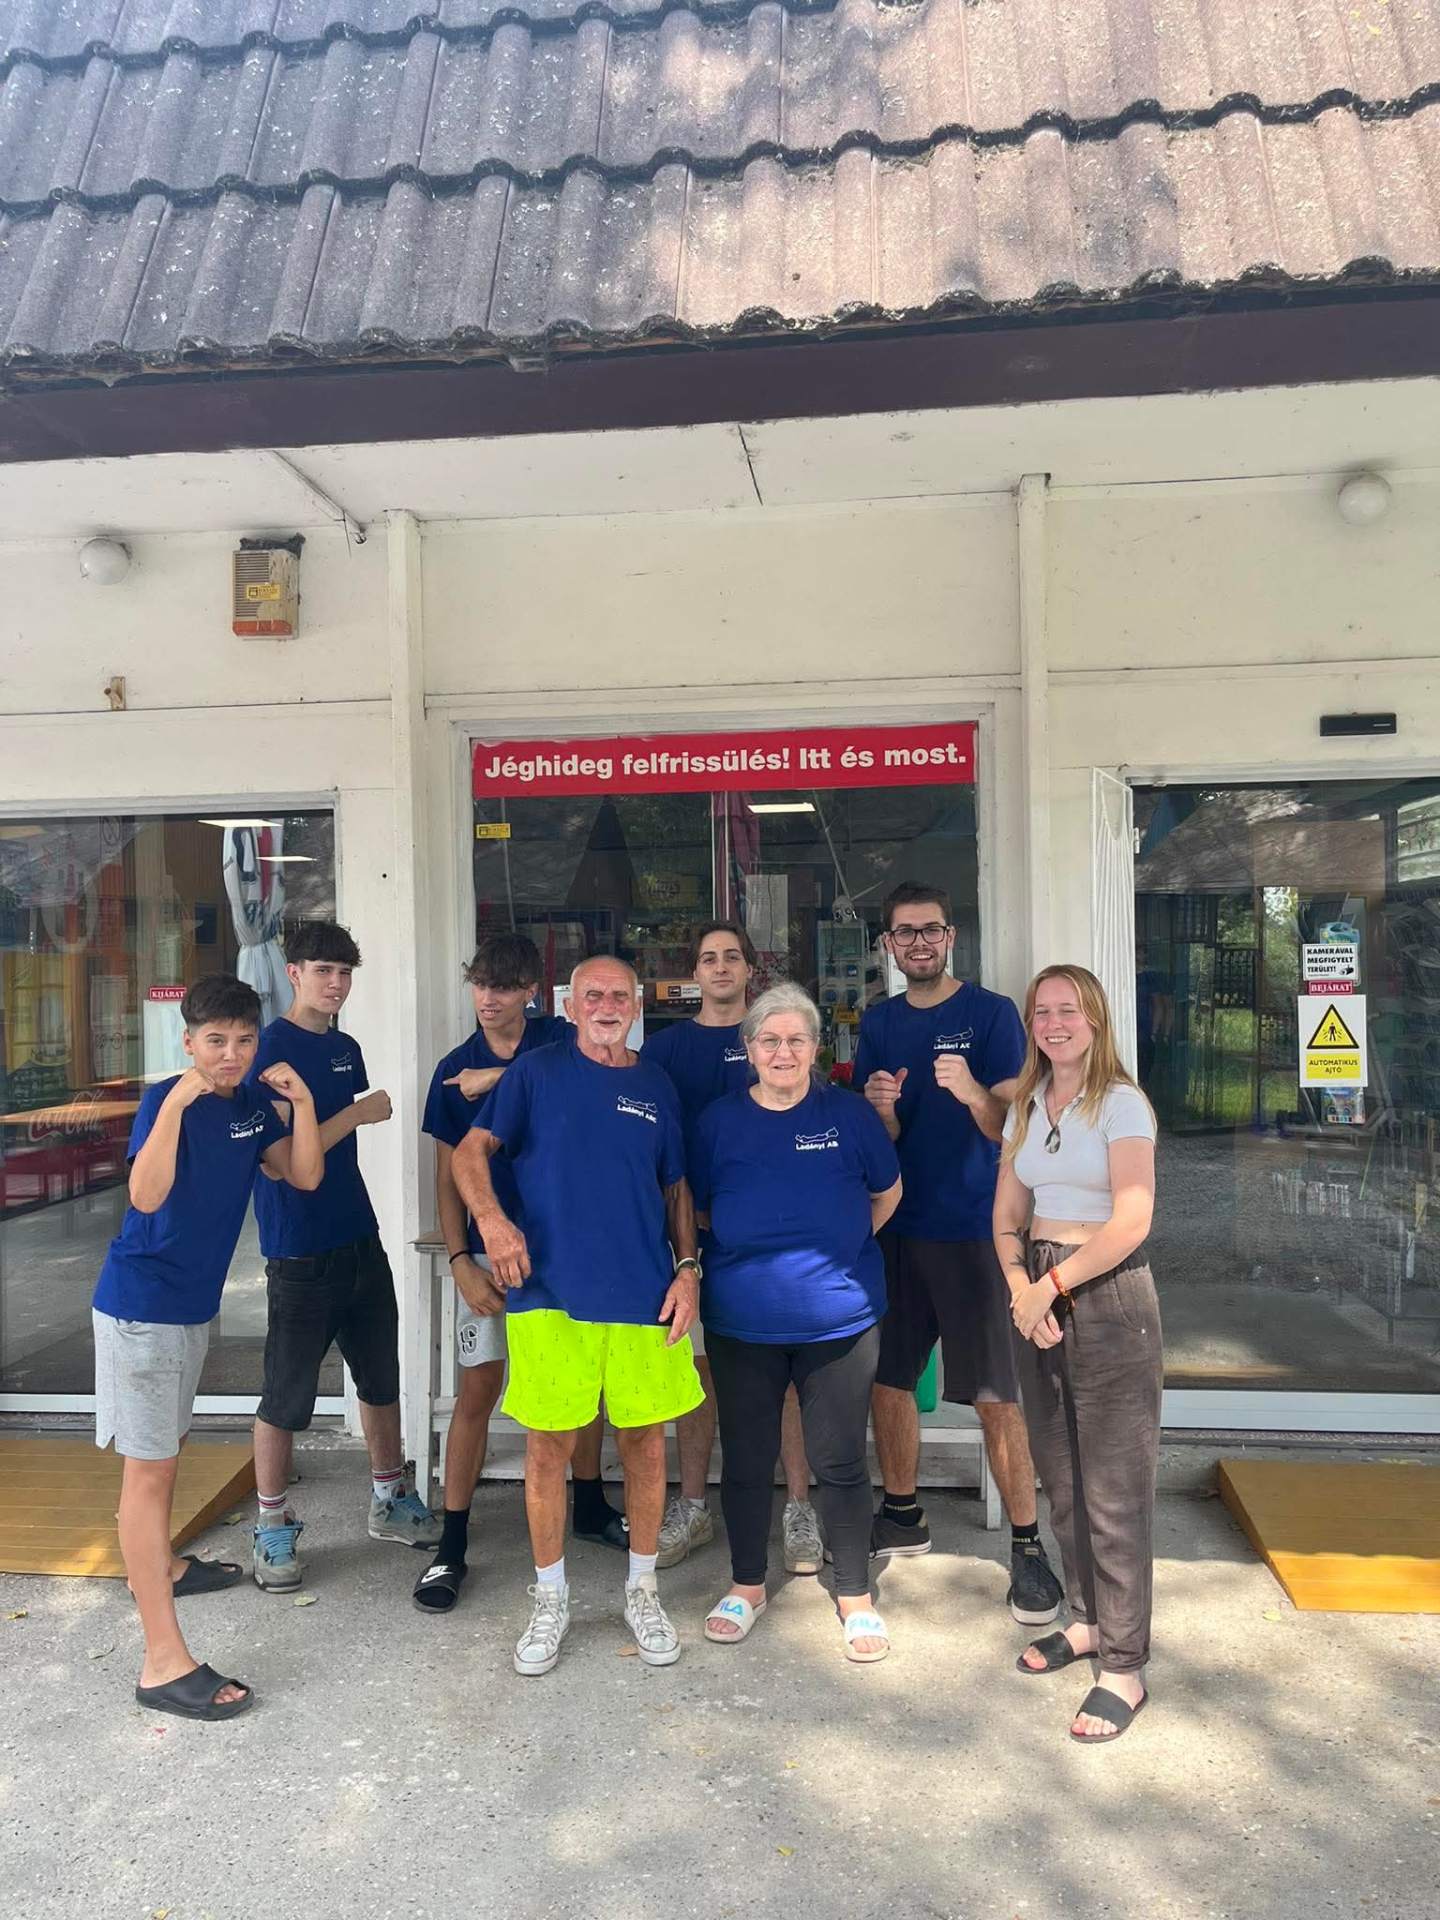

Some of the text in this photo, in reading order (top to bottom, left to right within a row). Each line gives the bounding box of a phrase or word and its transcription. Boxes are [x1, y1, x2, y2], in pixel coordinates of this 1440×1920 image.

[485, 743, 967, 782] Jéghideg felfrissülés! Itt és most.
[1307, 946, 1353, 955] KAMERÁVAL
[1307, 956, 1354, 965] MEGFIGYELT
[1307, 965, 1336, 973] TERÜLET!
[1311, 982, 1351, 993] BEJÁRAT
